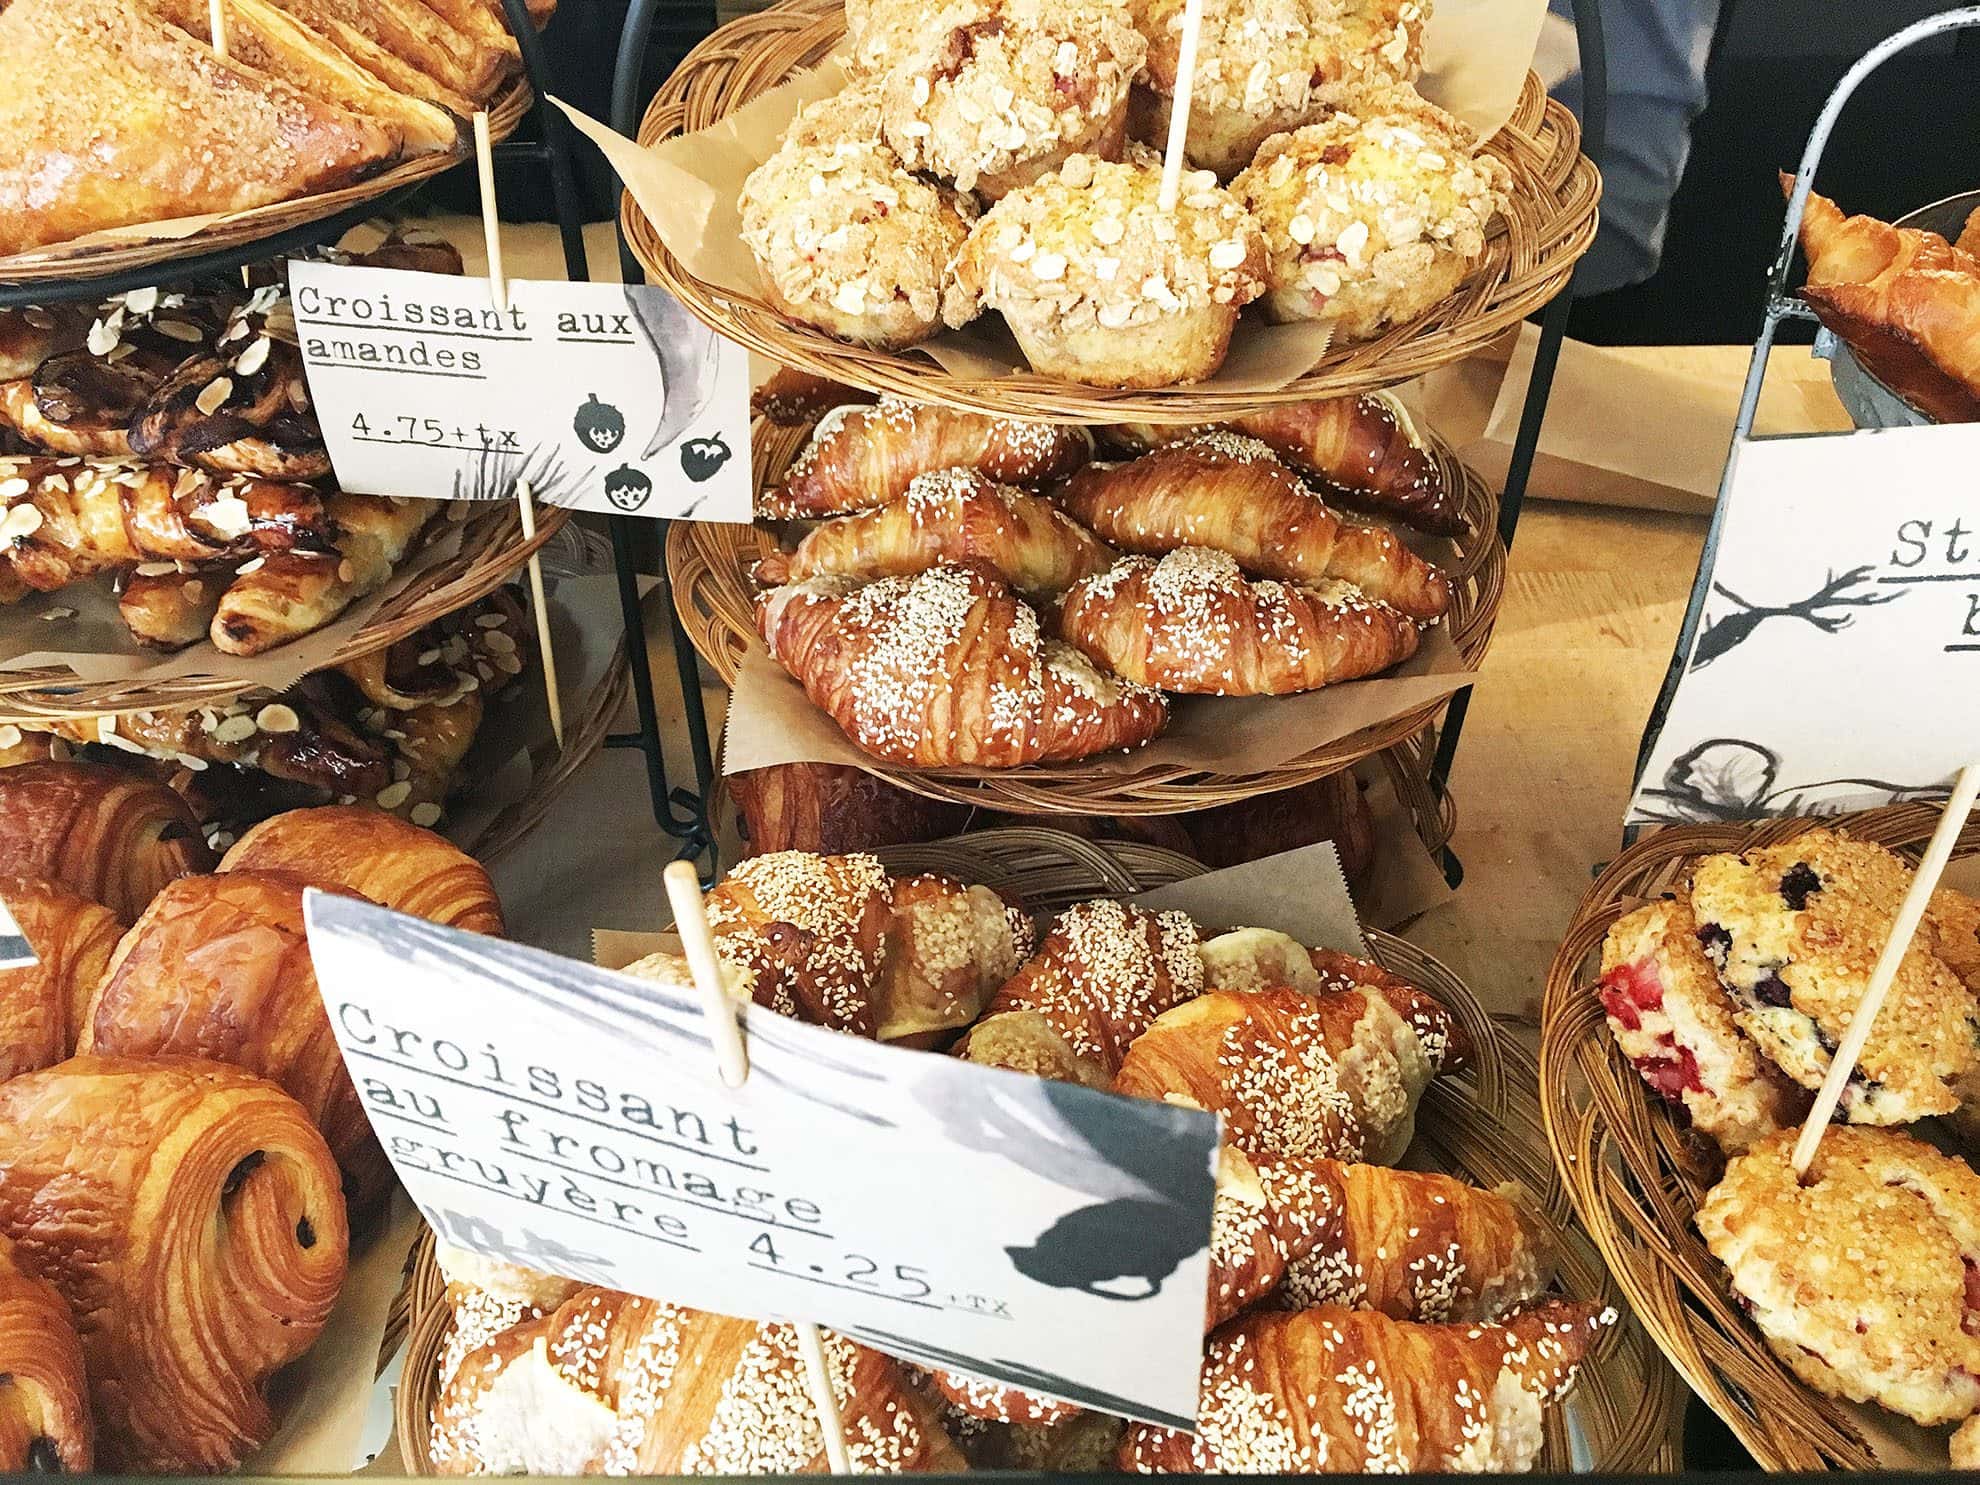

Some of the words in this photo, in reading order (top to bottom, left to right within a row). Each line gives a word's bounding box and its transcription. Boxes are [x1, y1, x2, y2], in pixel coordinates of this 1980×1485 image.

[298, 286, 527, 332] Croissant
[557, 309, 633, 336] aux
[307, 335, 482, 371] amandes
[1889, 517, 1980, 567] St
[338, 1002, 760, 1156] Croissant
[364, 1077, 449, 1123] au
[495, 1109, 823, 1225] fromage
[390, 1135, 689, 1238] gruyère
